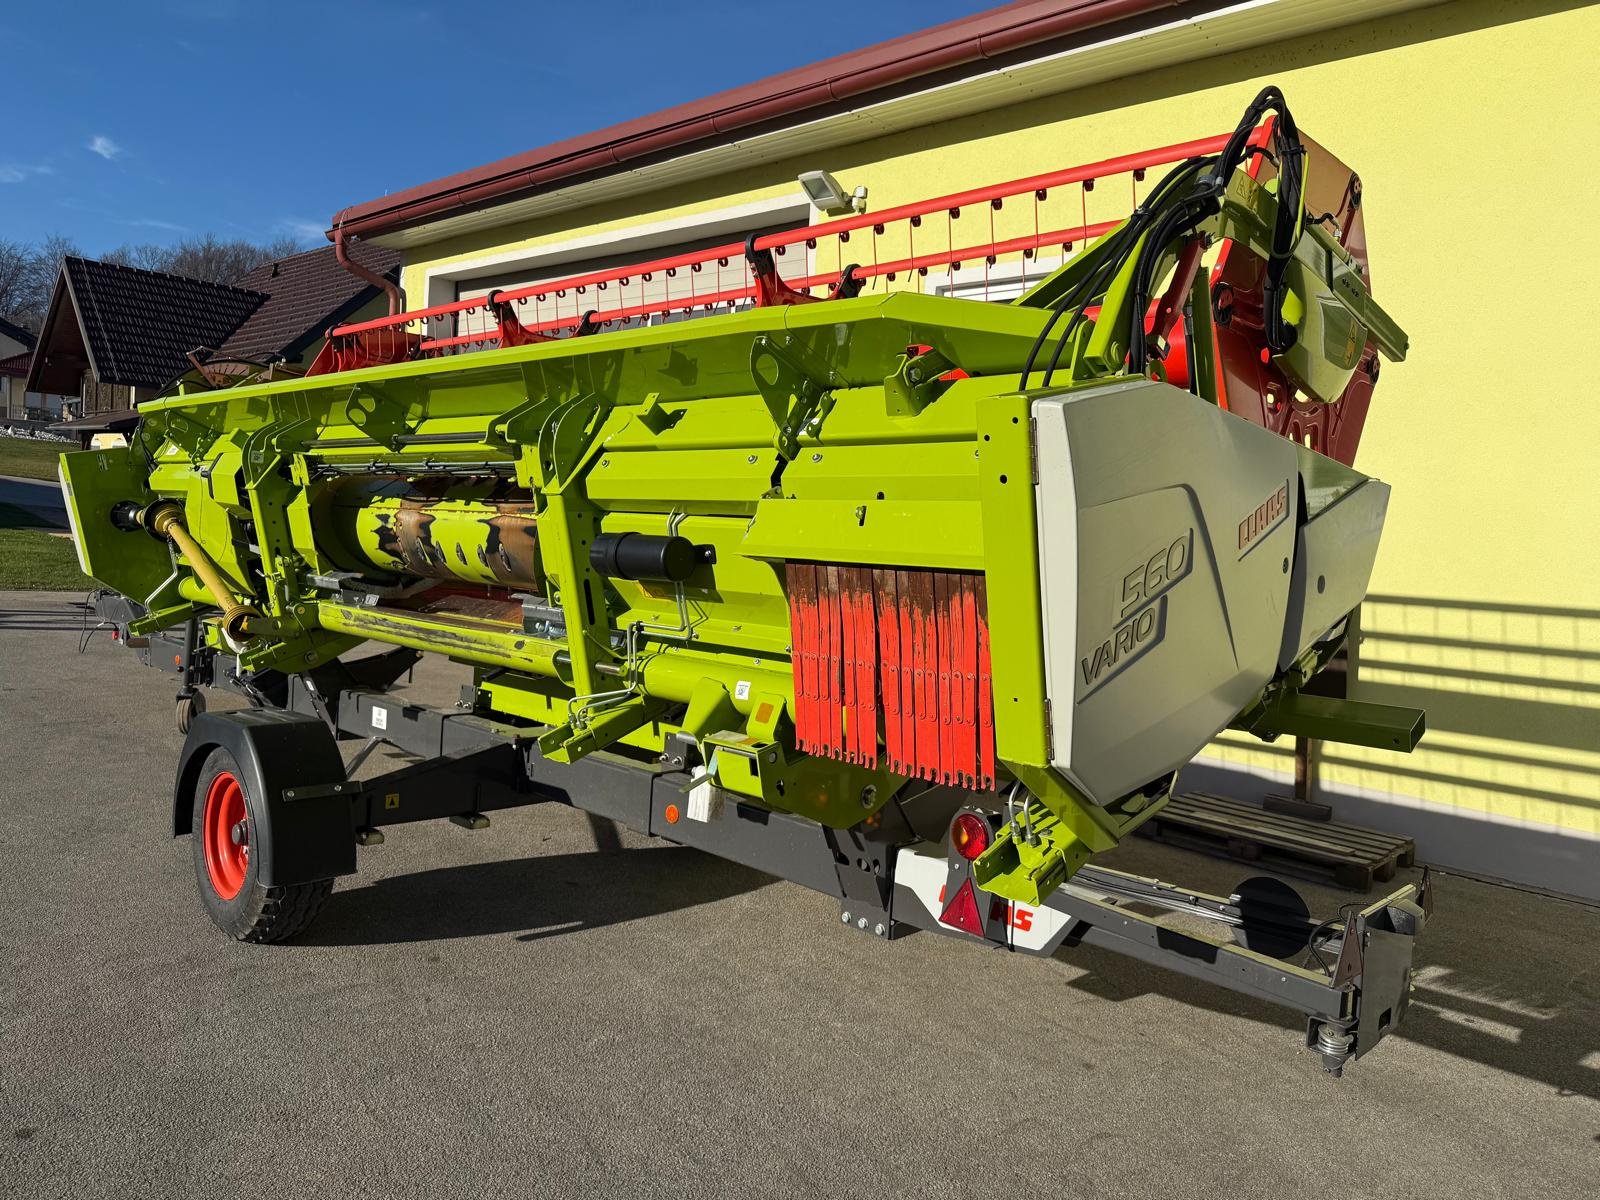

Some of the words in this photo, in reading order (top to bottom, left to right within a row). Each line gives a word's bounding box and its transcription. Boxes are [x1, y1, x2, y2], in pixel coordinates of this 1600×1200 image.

[1239, 486, 1286, 549] CLAAS
[1120, 535, 1188, 618] 560
[1081, 607, 1155, 685] VARIO
